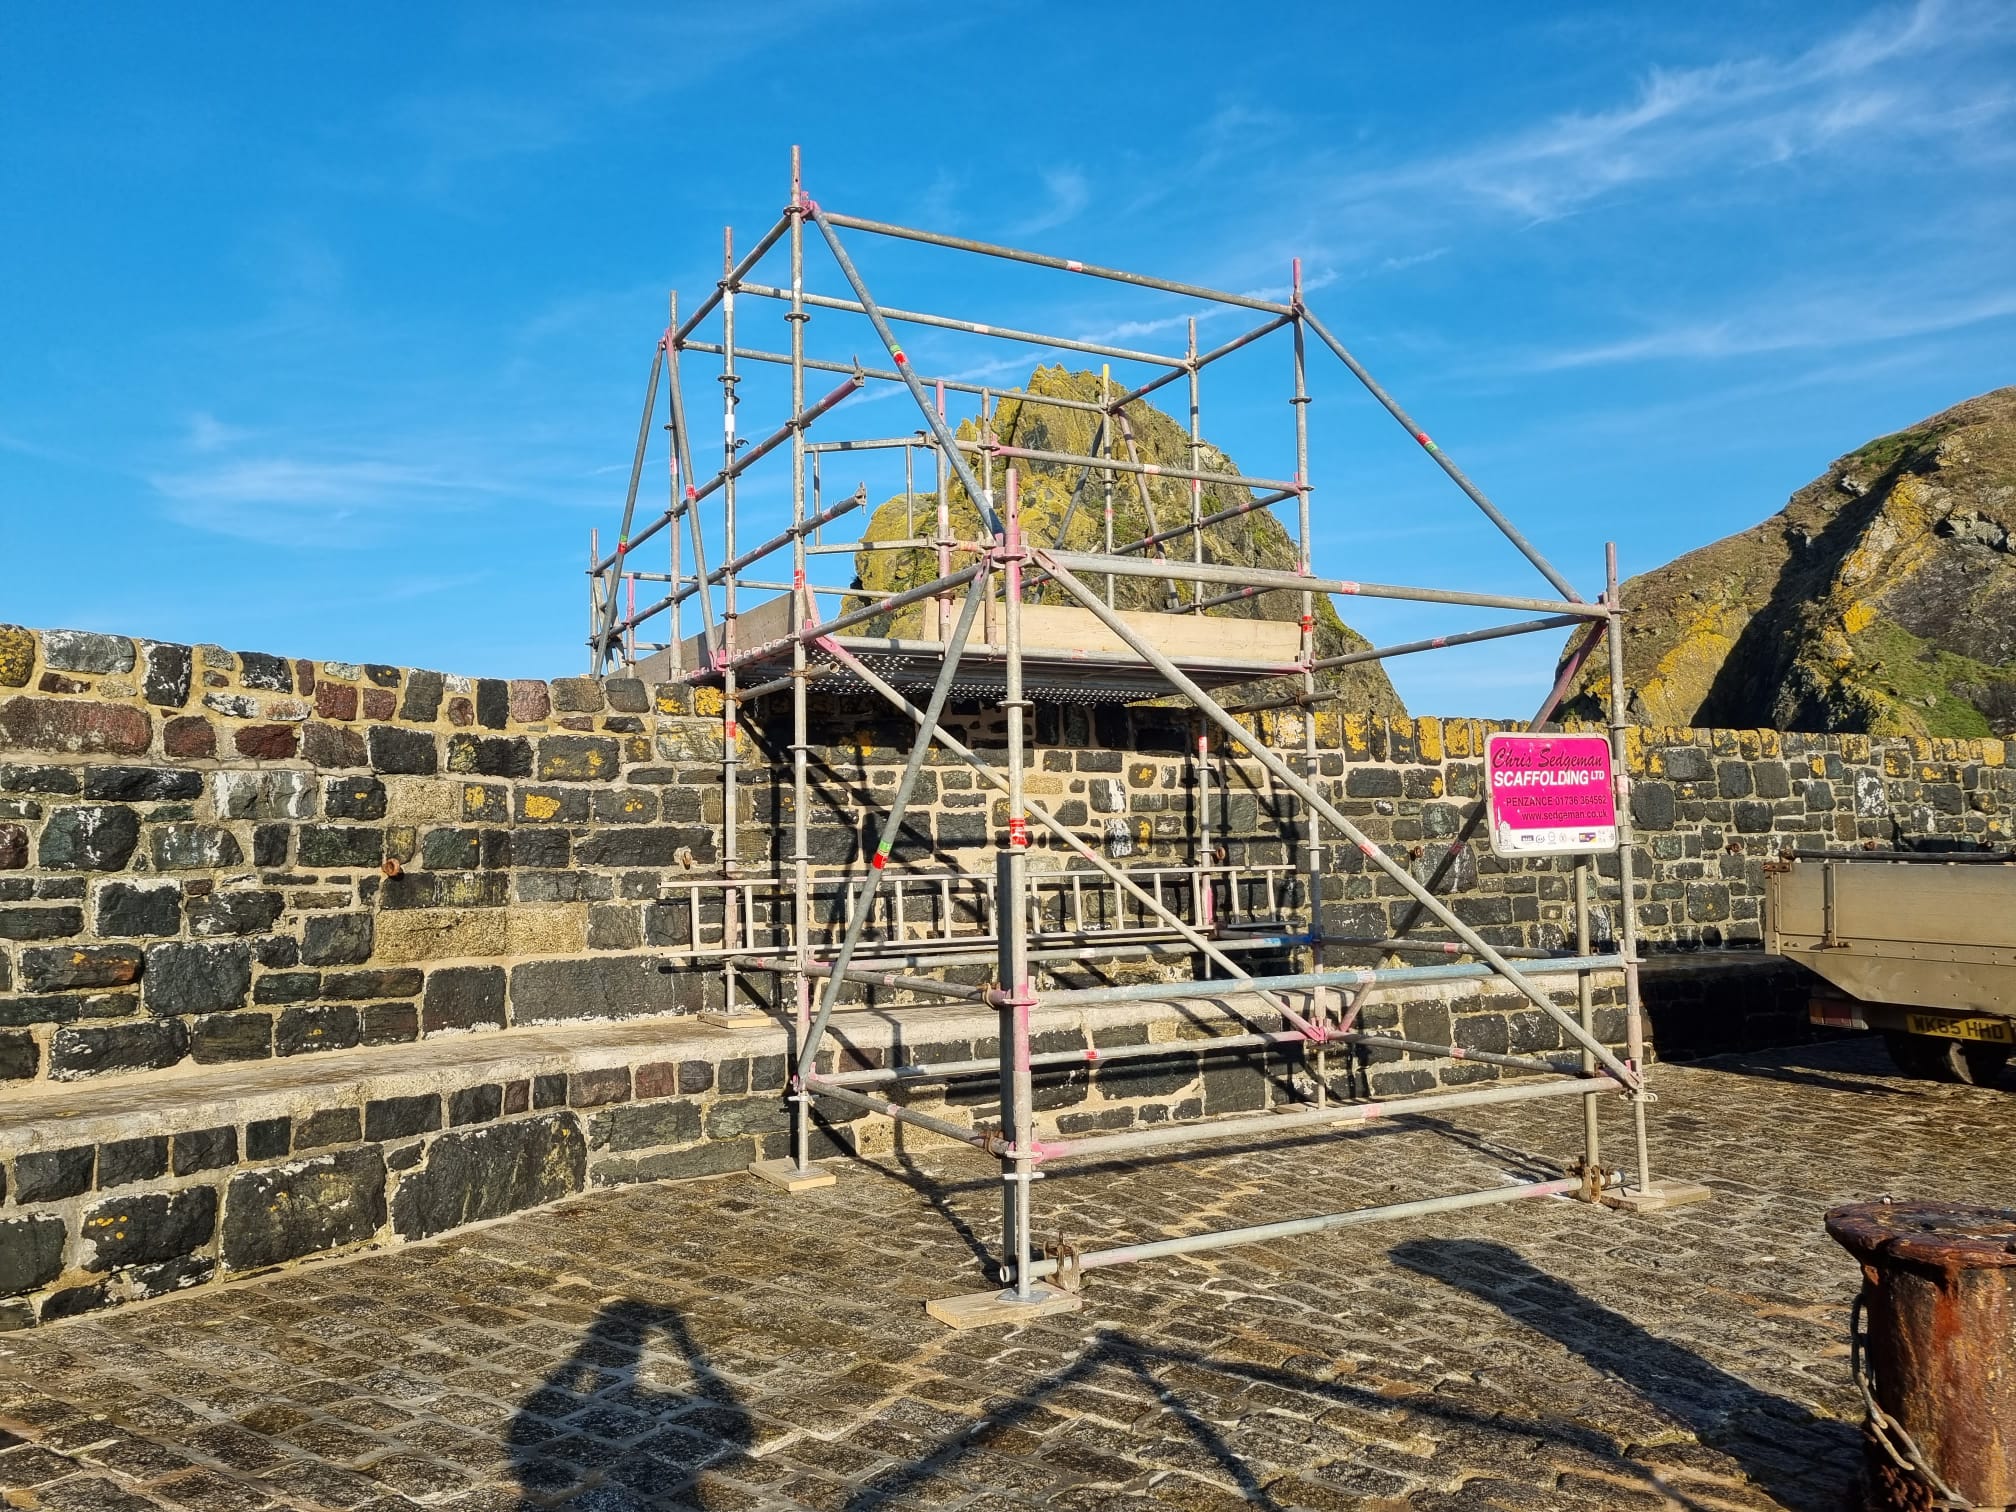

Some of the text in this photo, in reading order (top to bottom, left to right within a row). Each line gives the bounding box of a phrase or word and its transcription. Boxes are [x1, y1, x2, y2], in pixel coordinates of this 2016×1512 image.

[1492, 747, 1603, 771] Chris Sedgeman
[1494, 770, 1605, 787] SCAFFOLDING LTD
[1506, 796, 1553, 807] PENZANCE
[1555, 796, 1579, 806] 01736
[1521, 809, 1607, 822] www.sedgeman.co.uk
[1913, 1015, 1961, 1035] WK65
